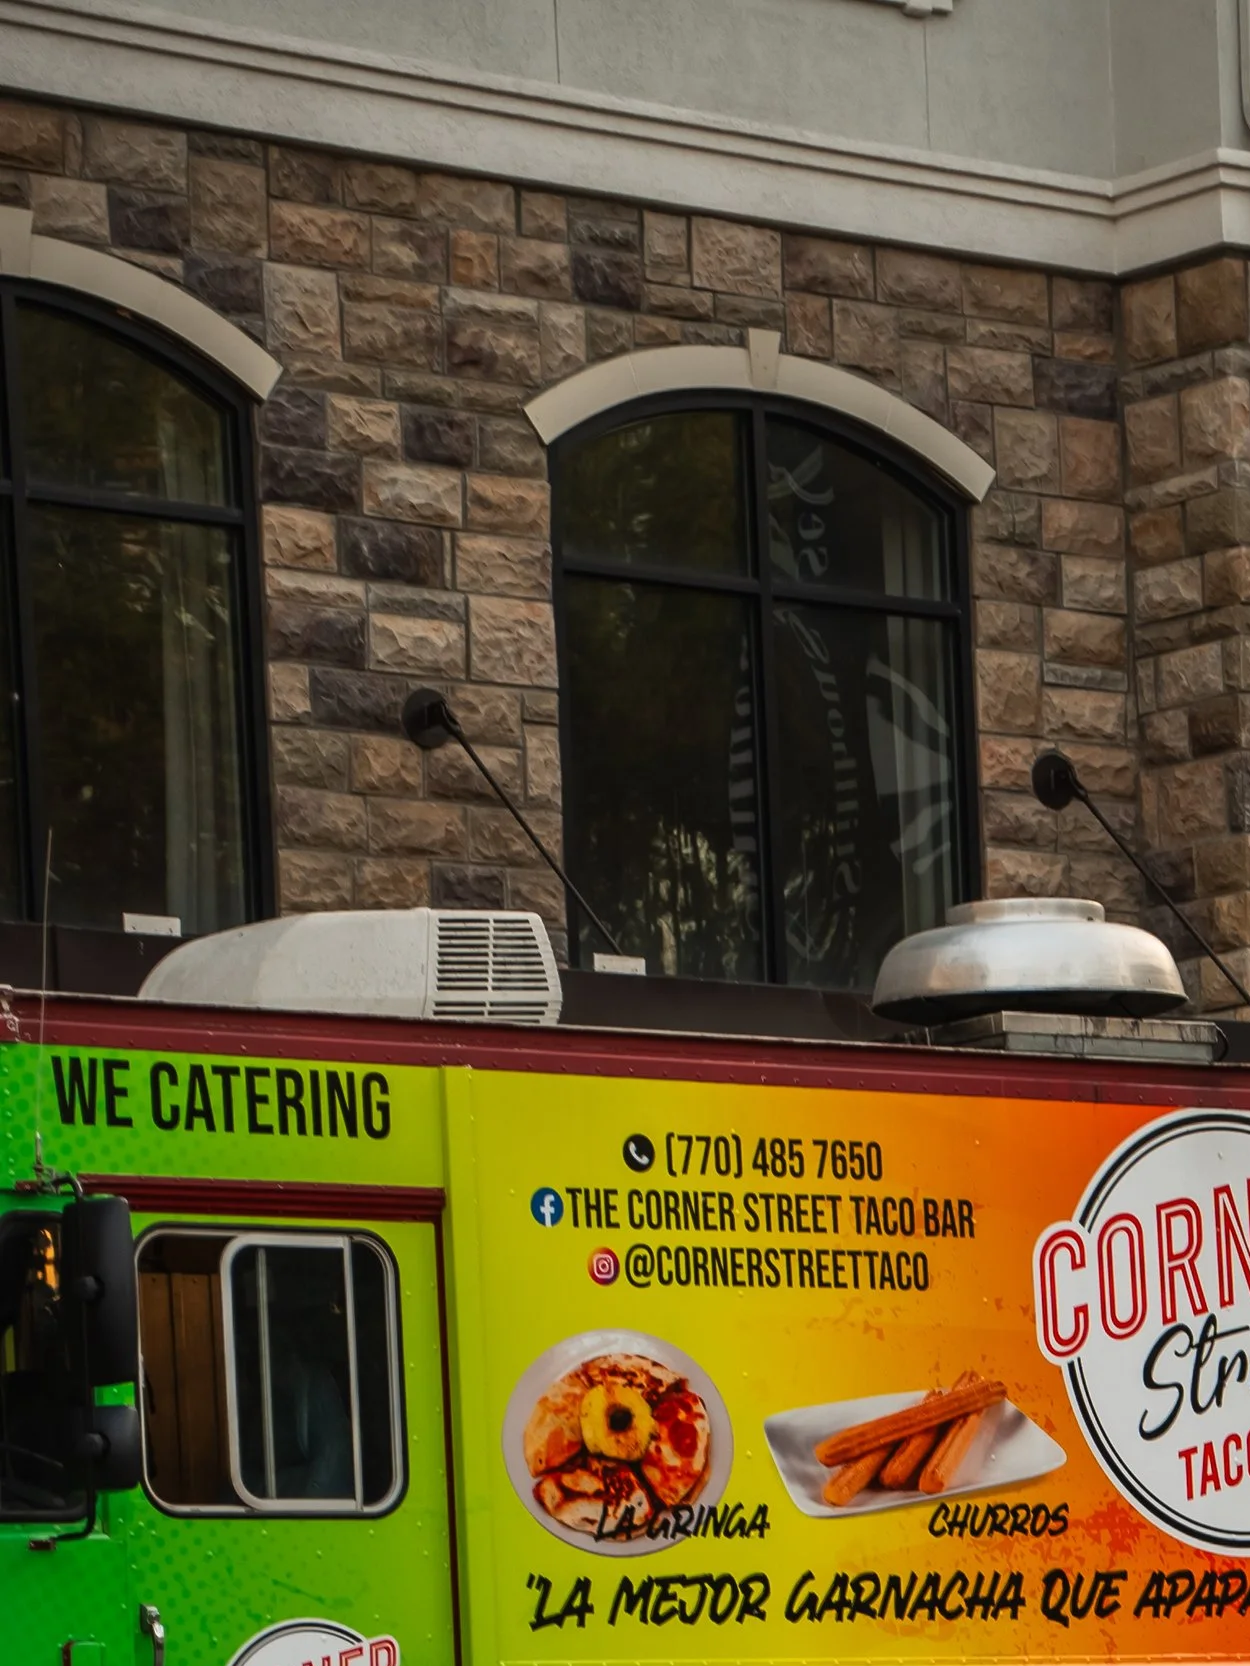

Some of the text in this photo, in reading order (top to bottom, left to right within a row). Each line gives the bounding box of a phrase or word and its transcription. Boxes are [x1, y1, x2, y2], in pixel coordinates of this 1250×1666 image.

[51, 1056, 391, 1140] WE CATERING
[666, 1132, 883, 1181] (770) 485 7650
[566, 1187, 975, 1239] THE CORNER STREET TACO BAR
[625, 1243, 930, 1292] @CORNERSTREETTACO
[595, 1503, 771, 1542] LA GRINGA
[928, 1502, 1069, 1538] CHURROS
[609, 1572, 770, 1626] MEJOR
[784, 1569, 1027, 1624] GARNACHA
[1041, 1568, 1127, 1628] QUE
